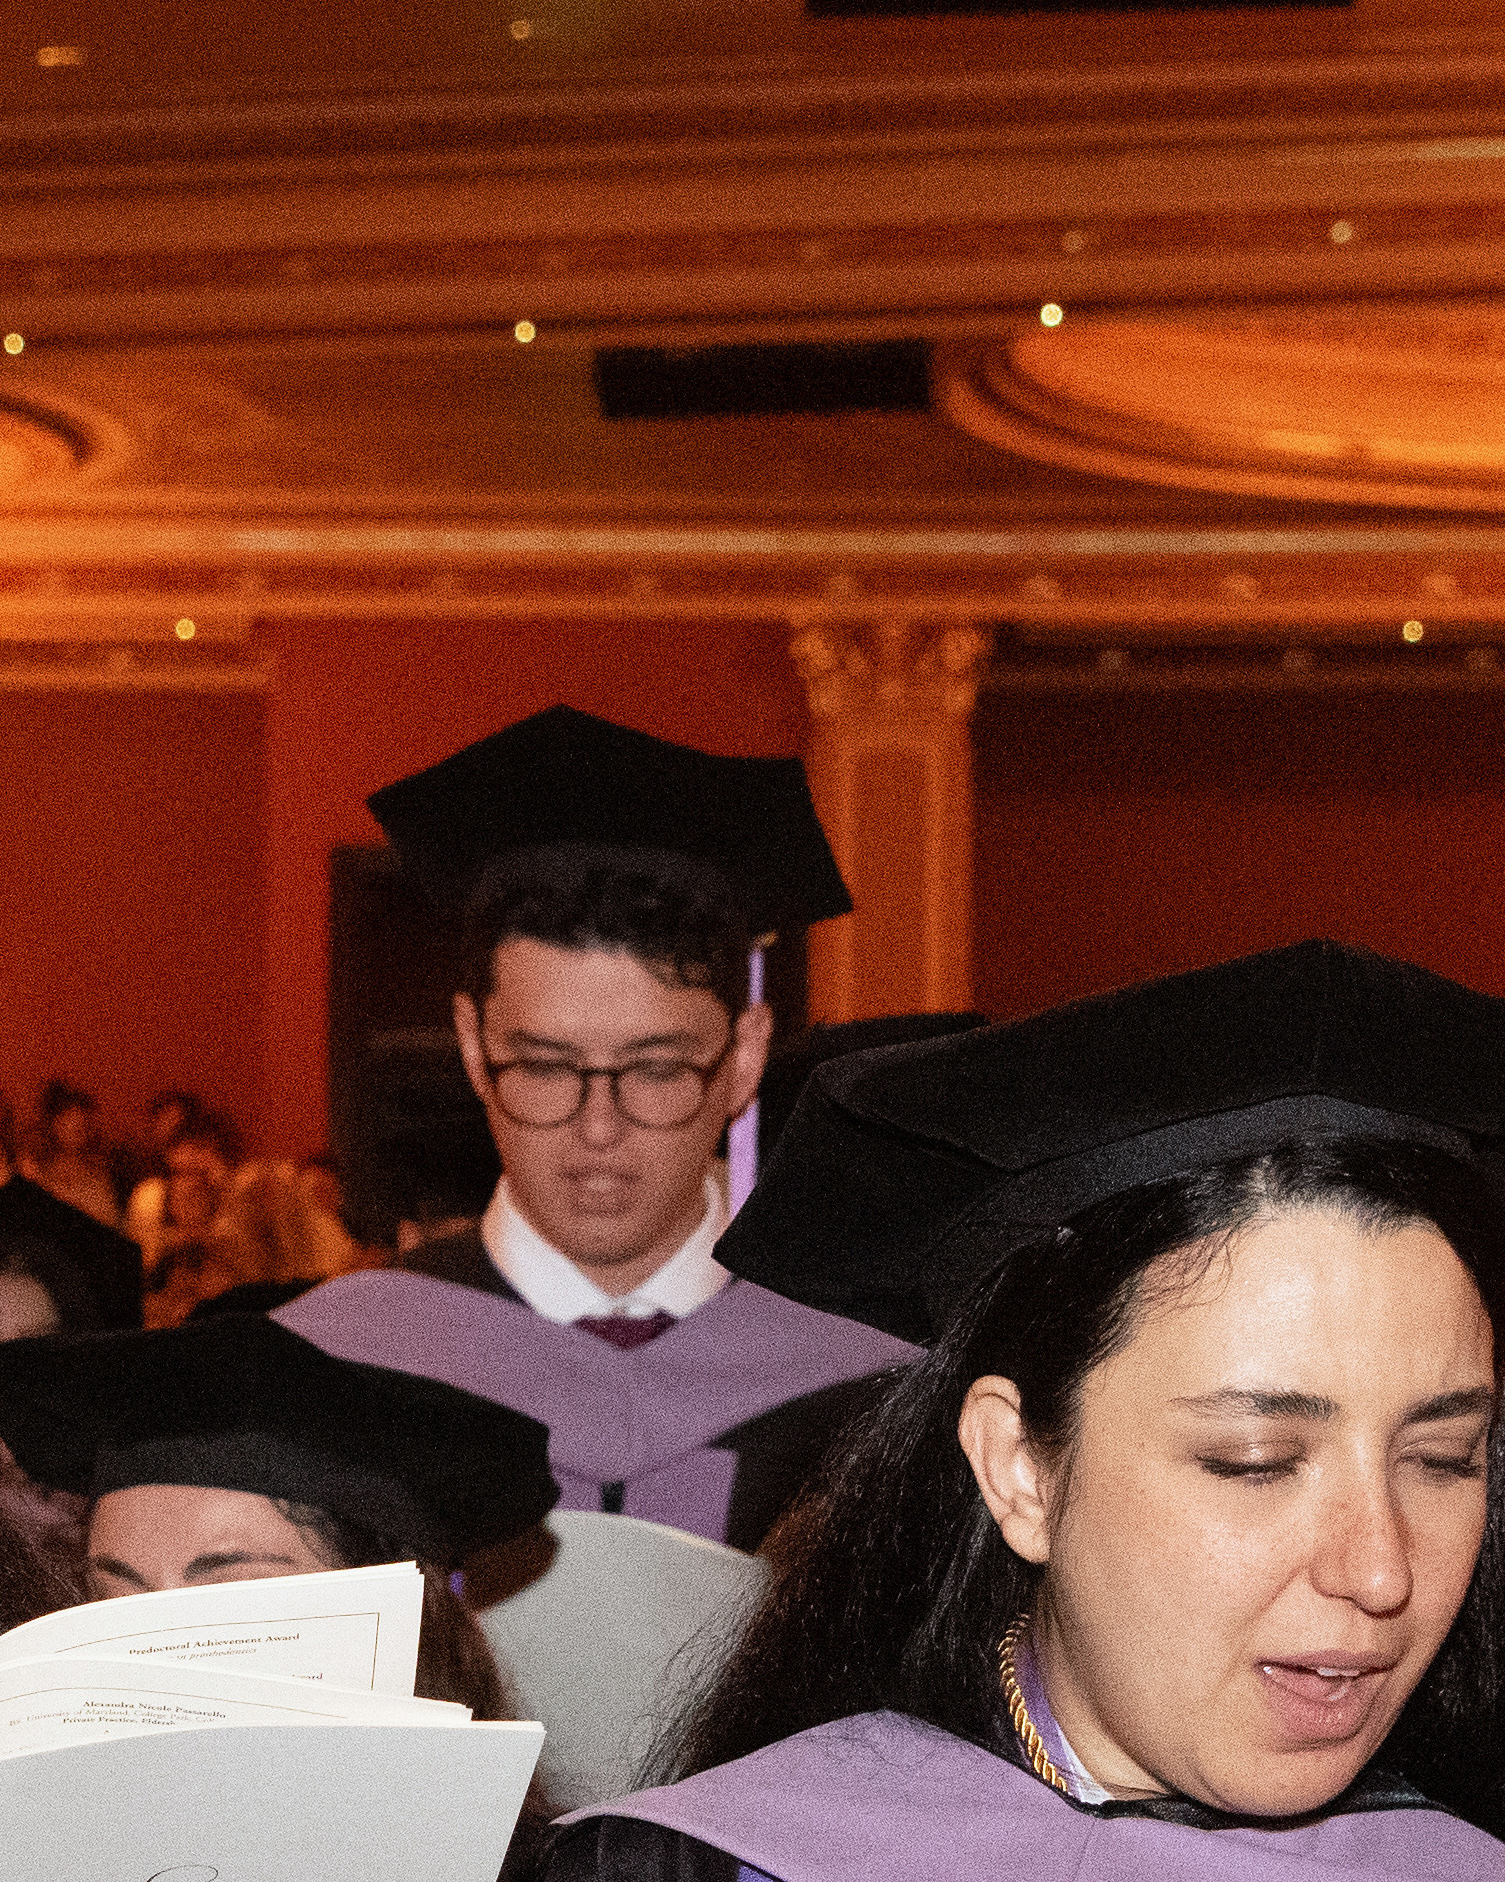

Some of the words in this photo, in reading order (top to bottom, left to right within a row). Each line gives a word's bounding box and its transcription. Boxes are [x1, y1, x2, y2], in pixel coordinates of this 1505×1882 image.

[129, 1642, 190, 1655] Predoctoral
[193, 1637, 262, 1648] Achievement
[265, 1633, 300, 1643] Award
